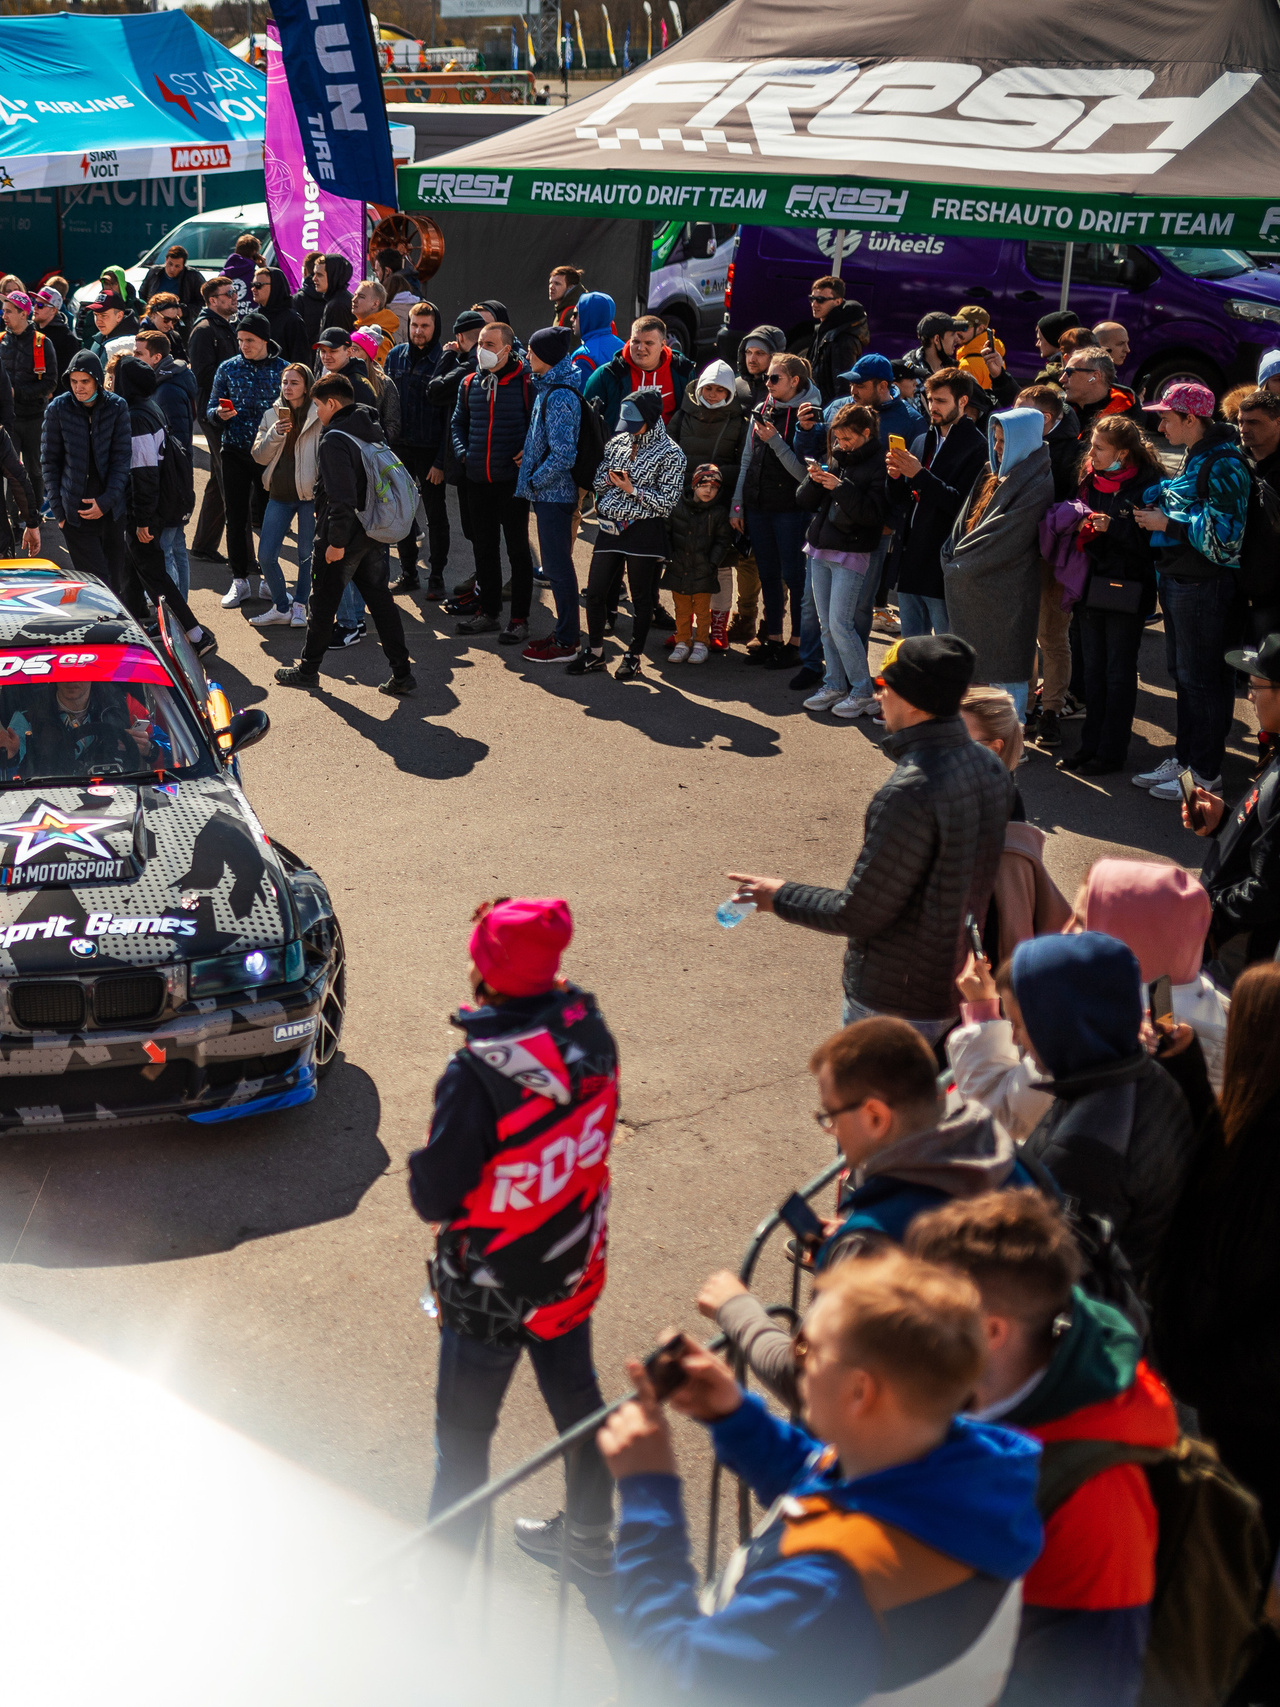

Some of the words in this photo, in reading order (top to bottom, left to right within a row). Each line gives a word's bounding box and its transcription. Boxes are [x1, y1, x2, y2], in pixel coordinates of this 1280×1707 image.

[170, 68, 257, 95] START
[35, 95, 135, 113] AIRLINE
[194, 95, 266, 122] VOL
[89, 150, 118, 162] START
[173, 146, 229, 169] MOTUL
[307, 112, 336, 180] TIRE
[90, 164, 119, 178] VOLT
[531, 181, 642, 205] FRESHAUTO
[646, 184, 705, 207] DRIFT
[709, 187, 767, 209] TEAM
[100, 221, 113, 233] 53
[932, 197, 1072, 229] FRESHAUTO
[1079, 207, 1151, 235] DRIFT
[1159, 211, 1235, 236] TEAM
[868, 235, 945, 254] wheels
[58, 653, 99, 667] GP
[85, 912, 197, 937] Games
[490, 1103, 608, 1213] RDS
